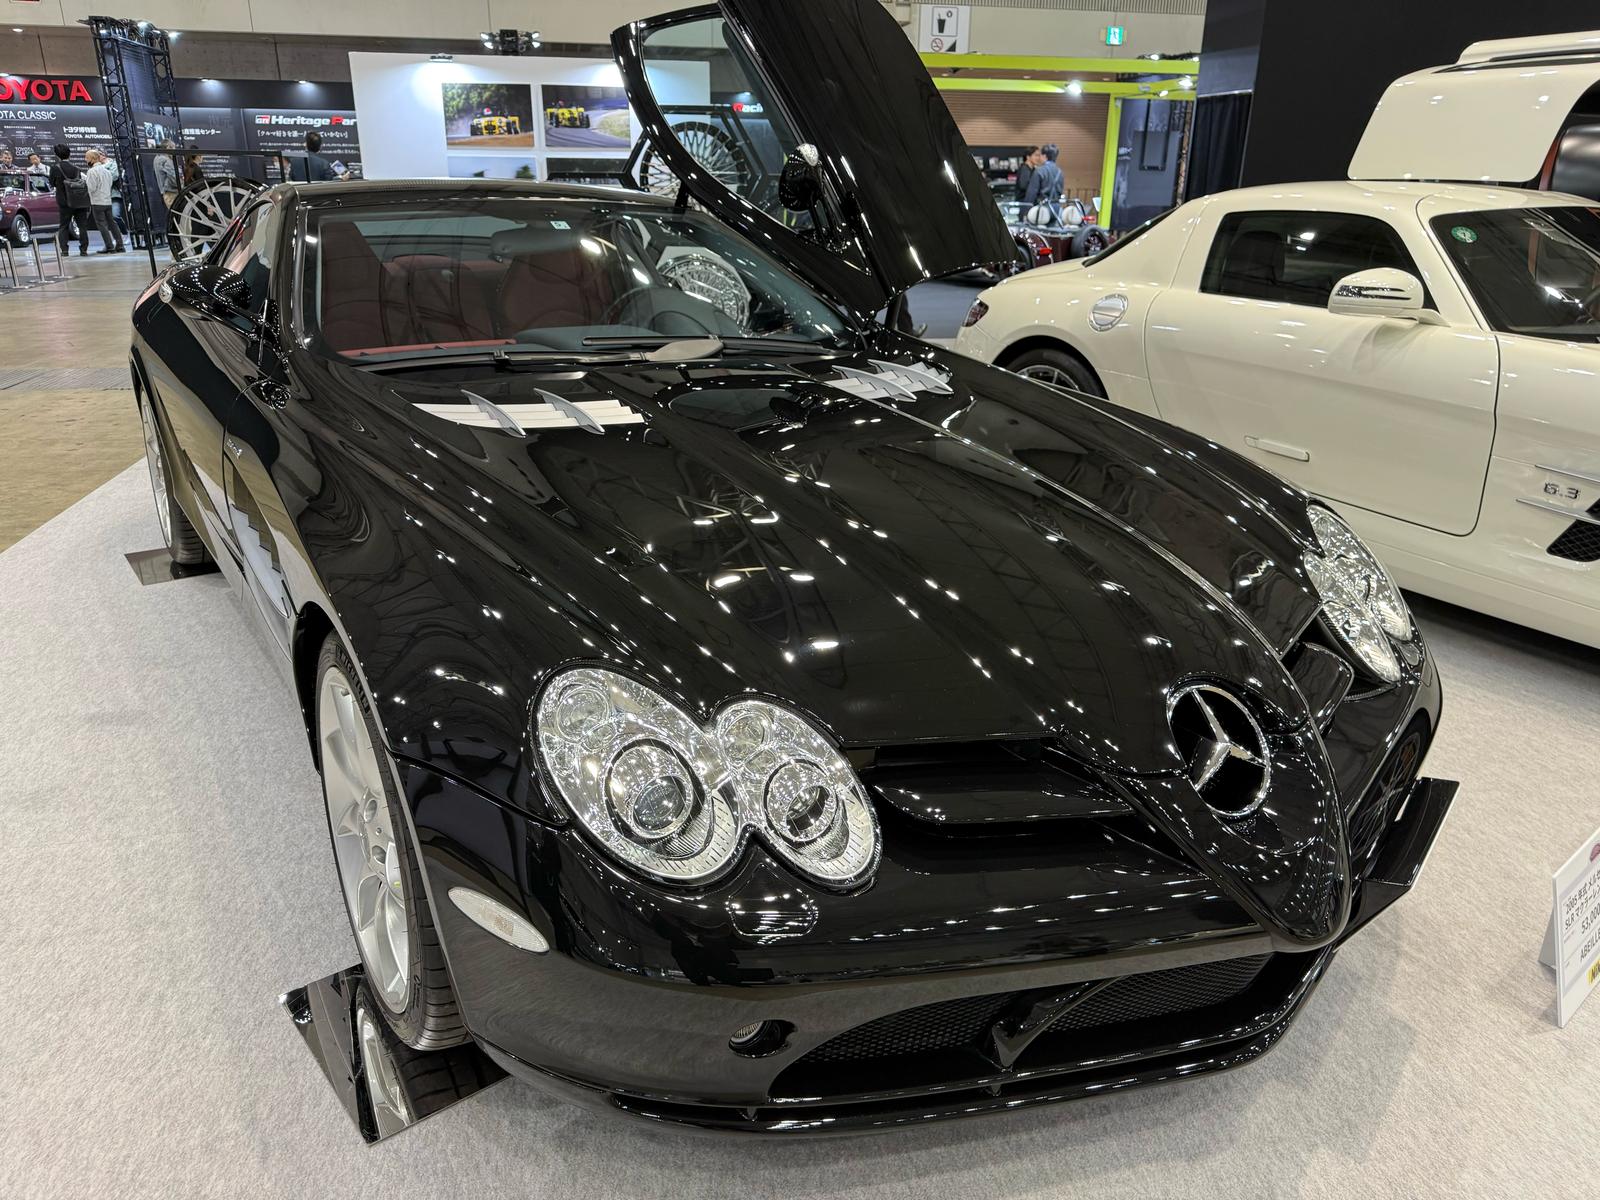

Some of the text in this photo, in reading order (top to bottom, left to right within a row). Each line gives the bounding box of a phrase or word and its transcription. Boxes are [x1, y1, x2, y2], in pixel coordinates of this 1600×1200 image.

[17, 110, 56, 120] CLASSIC
[271, 115, 331, 127] Heritage
[1543, 482, 1580, 500] 6.3
